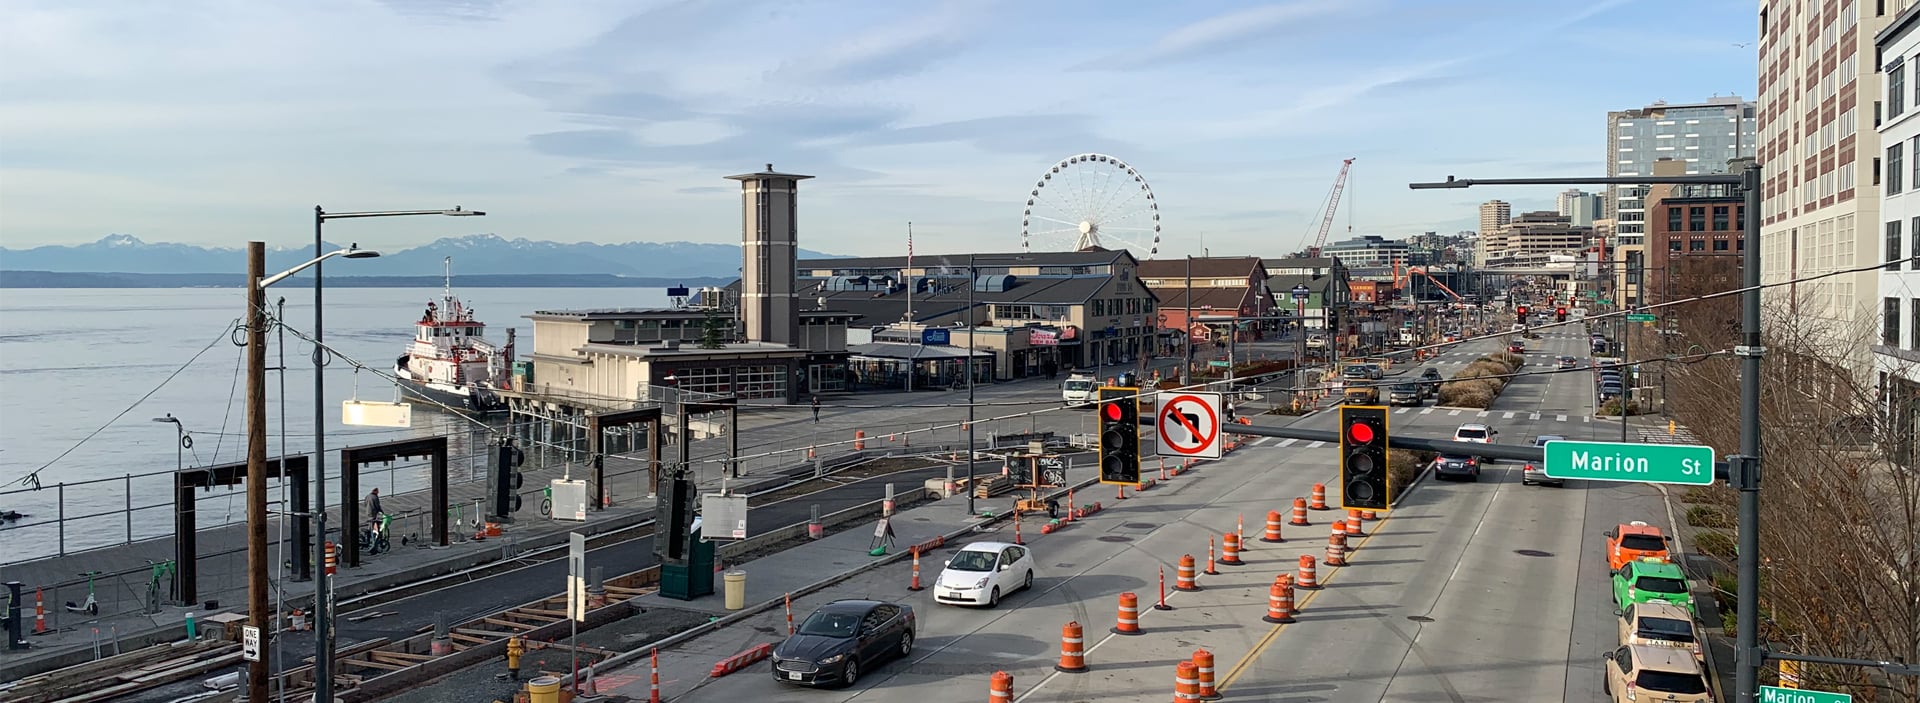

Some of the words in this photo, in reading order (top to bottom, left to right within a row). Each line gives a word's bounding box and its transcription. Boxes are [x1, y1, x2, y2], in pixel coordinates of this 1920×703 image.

[1571, 451, 1649, 473] Marion
[1681, 458, 1701, 476] St
[245, 629, 257, 639] ONE
[245, 639, 258, 647] WAY
[1764, 689, 1815, 703] Marion
